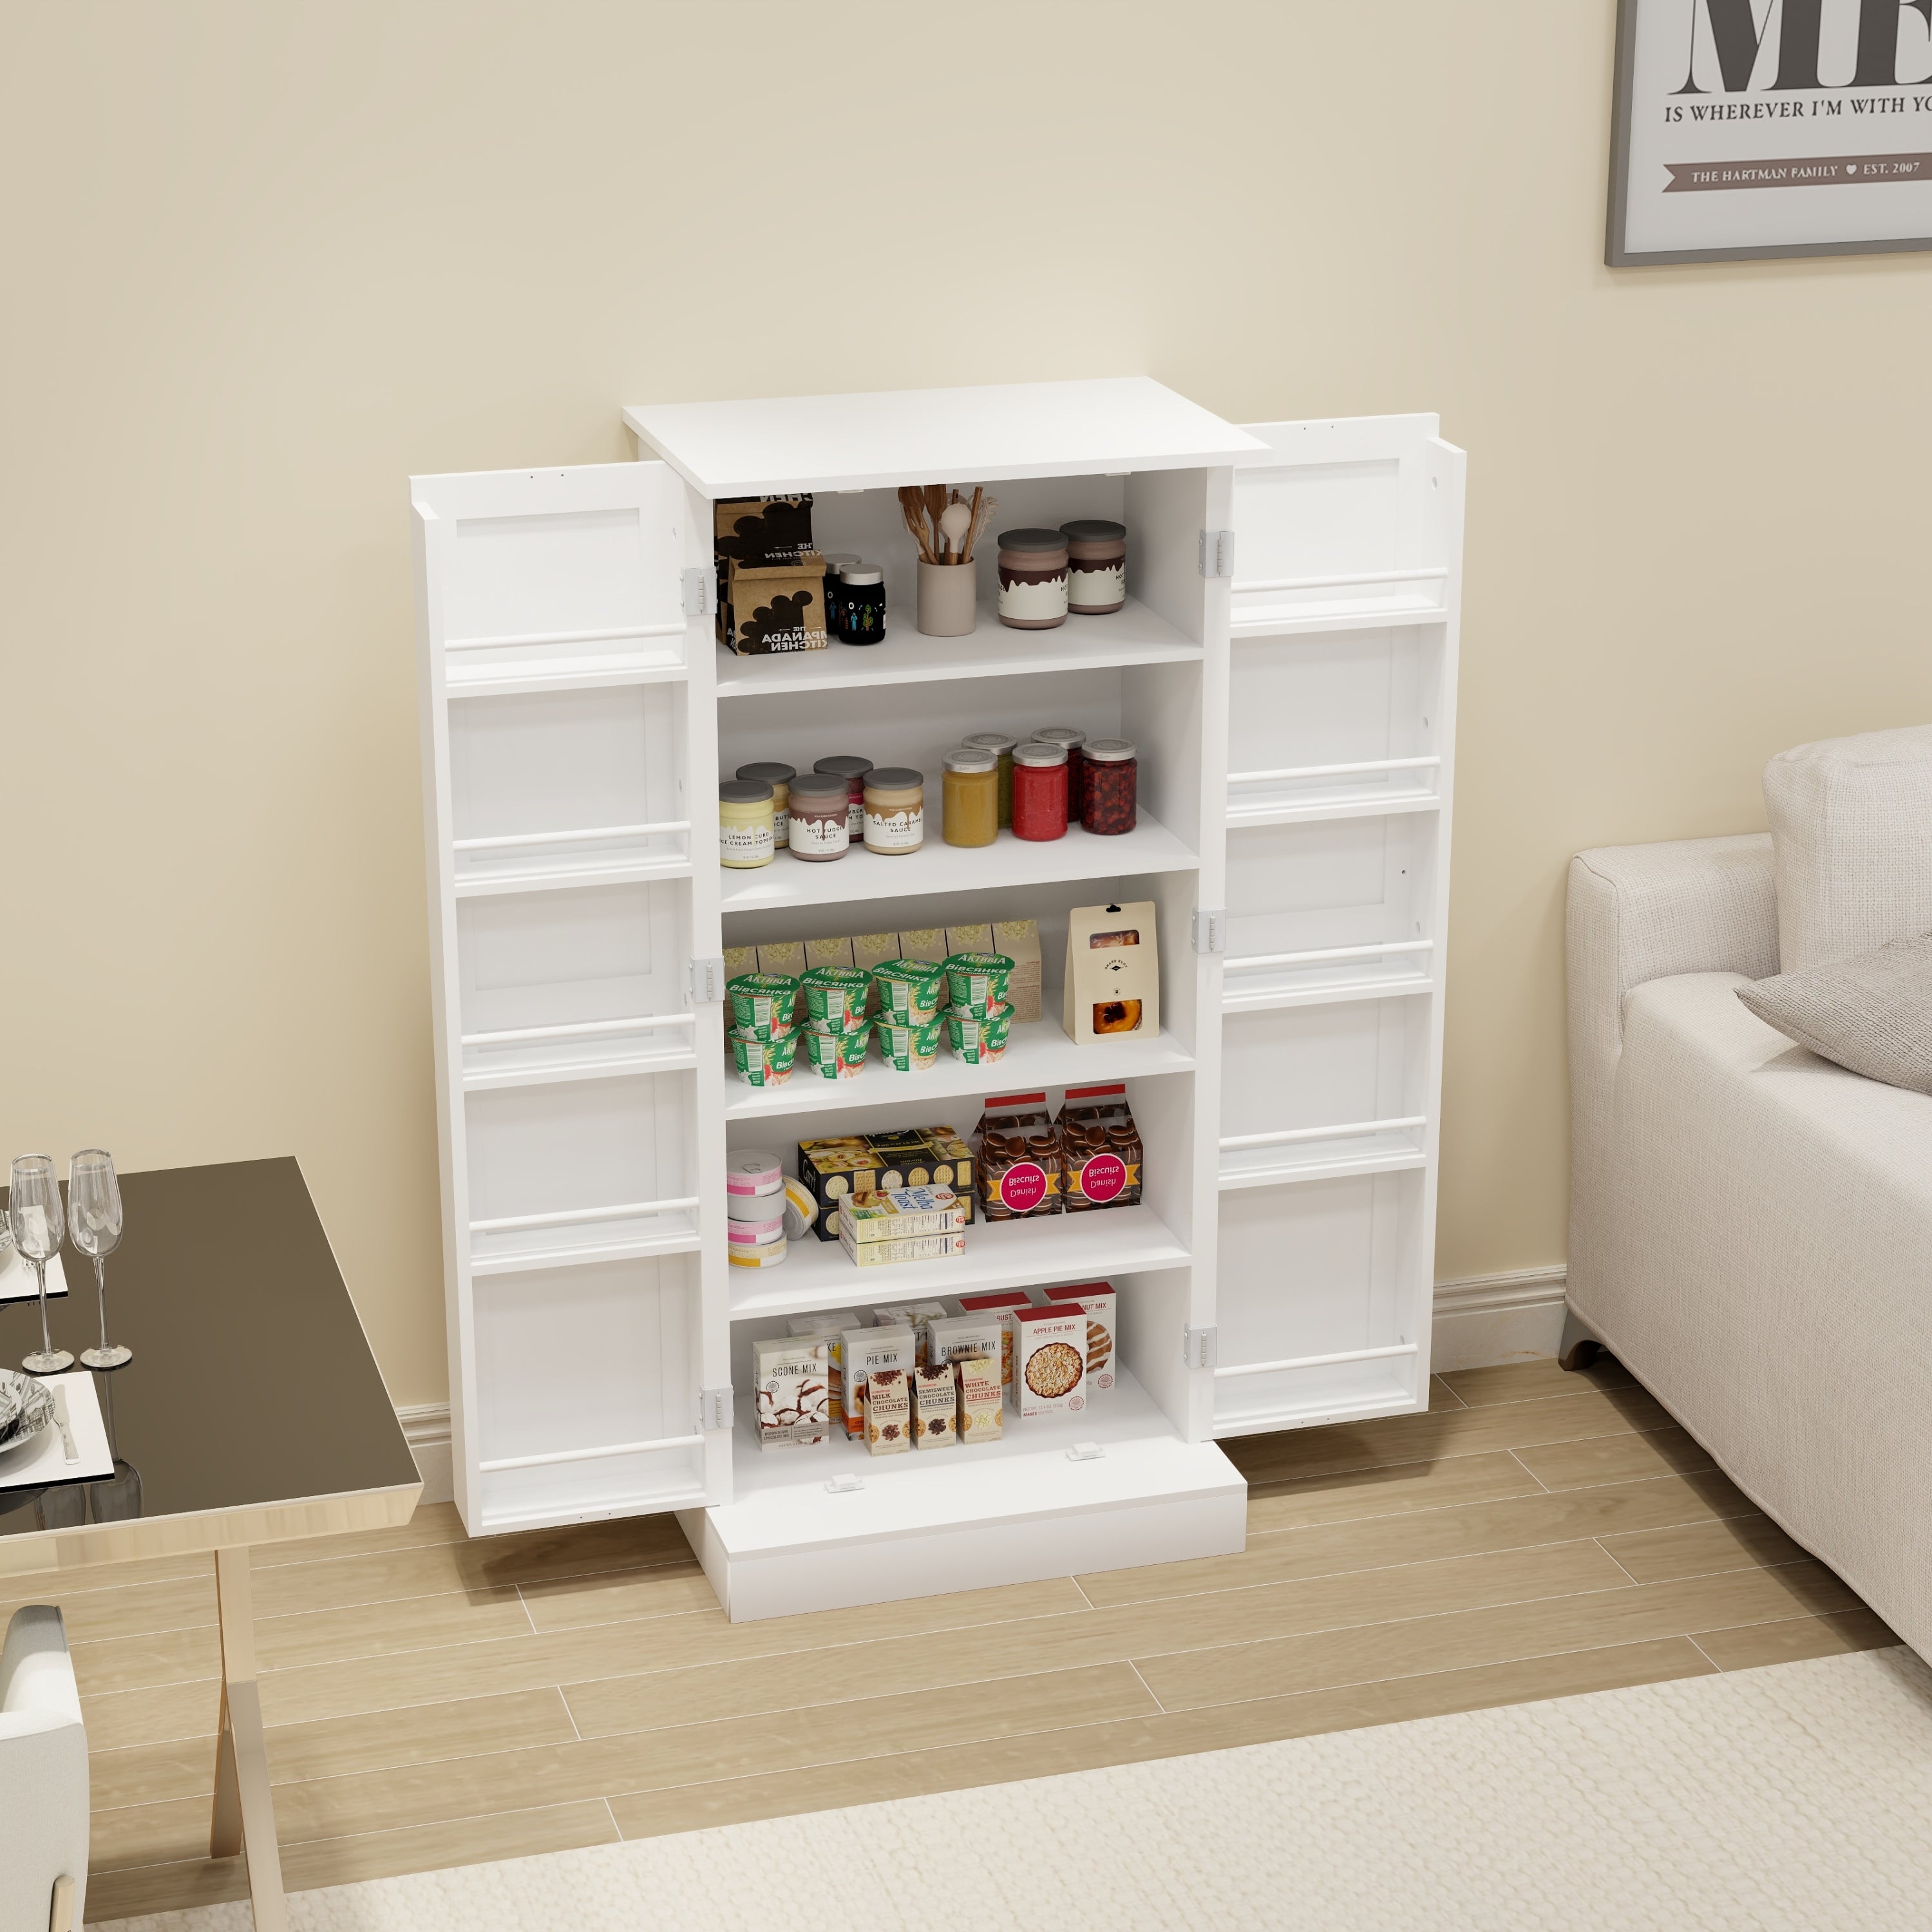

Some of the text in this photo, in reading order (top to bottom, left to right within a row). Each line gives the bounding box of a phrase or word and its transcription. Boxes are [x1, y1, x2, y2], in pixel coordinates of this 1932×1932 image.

[1665, 106, 1683, 122] IS
[1690, 101, 1804, 122] WHEREVER
[1812, 99, 1842, 116] I'M
[1850, 97, 1904, 115] WITH
[1691, 162, 1920, 183] THE HARTMAN FAMILY EST. 2007
[891, 1191, 918, 1209] Toast
[905, 1188, 934, 1209] Melba
[1033, 1327, 1052, 1335] APPLE
[942, 1341, 996, 1356] BROWNIE MIX
[866, 1353, 898, 1366] PIE MIX
[773, 1363, 817, 1378] SCONE MIX
[918, 1385, 954, 1394] SEMISWEET
[965, 1385, 1001, 1394] CHOCOLATE
[966, 1390, 1001, 1399] CHUNKS
[919, 1391, 954, 1399] CHOCOLATE
[872, 1397, 908, 1405] CHOCOLATE
[920, 1396, 955, 1406] CHUNKS
[873, 1403, 909, 1412] CHUNKS
